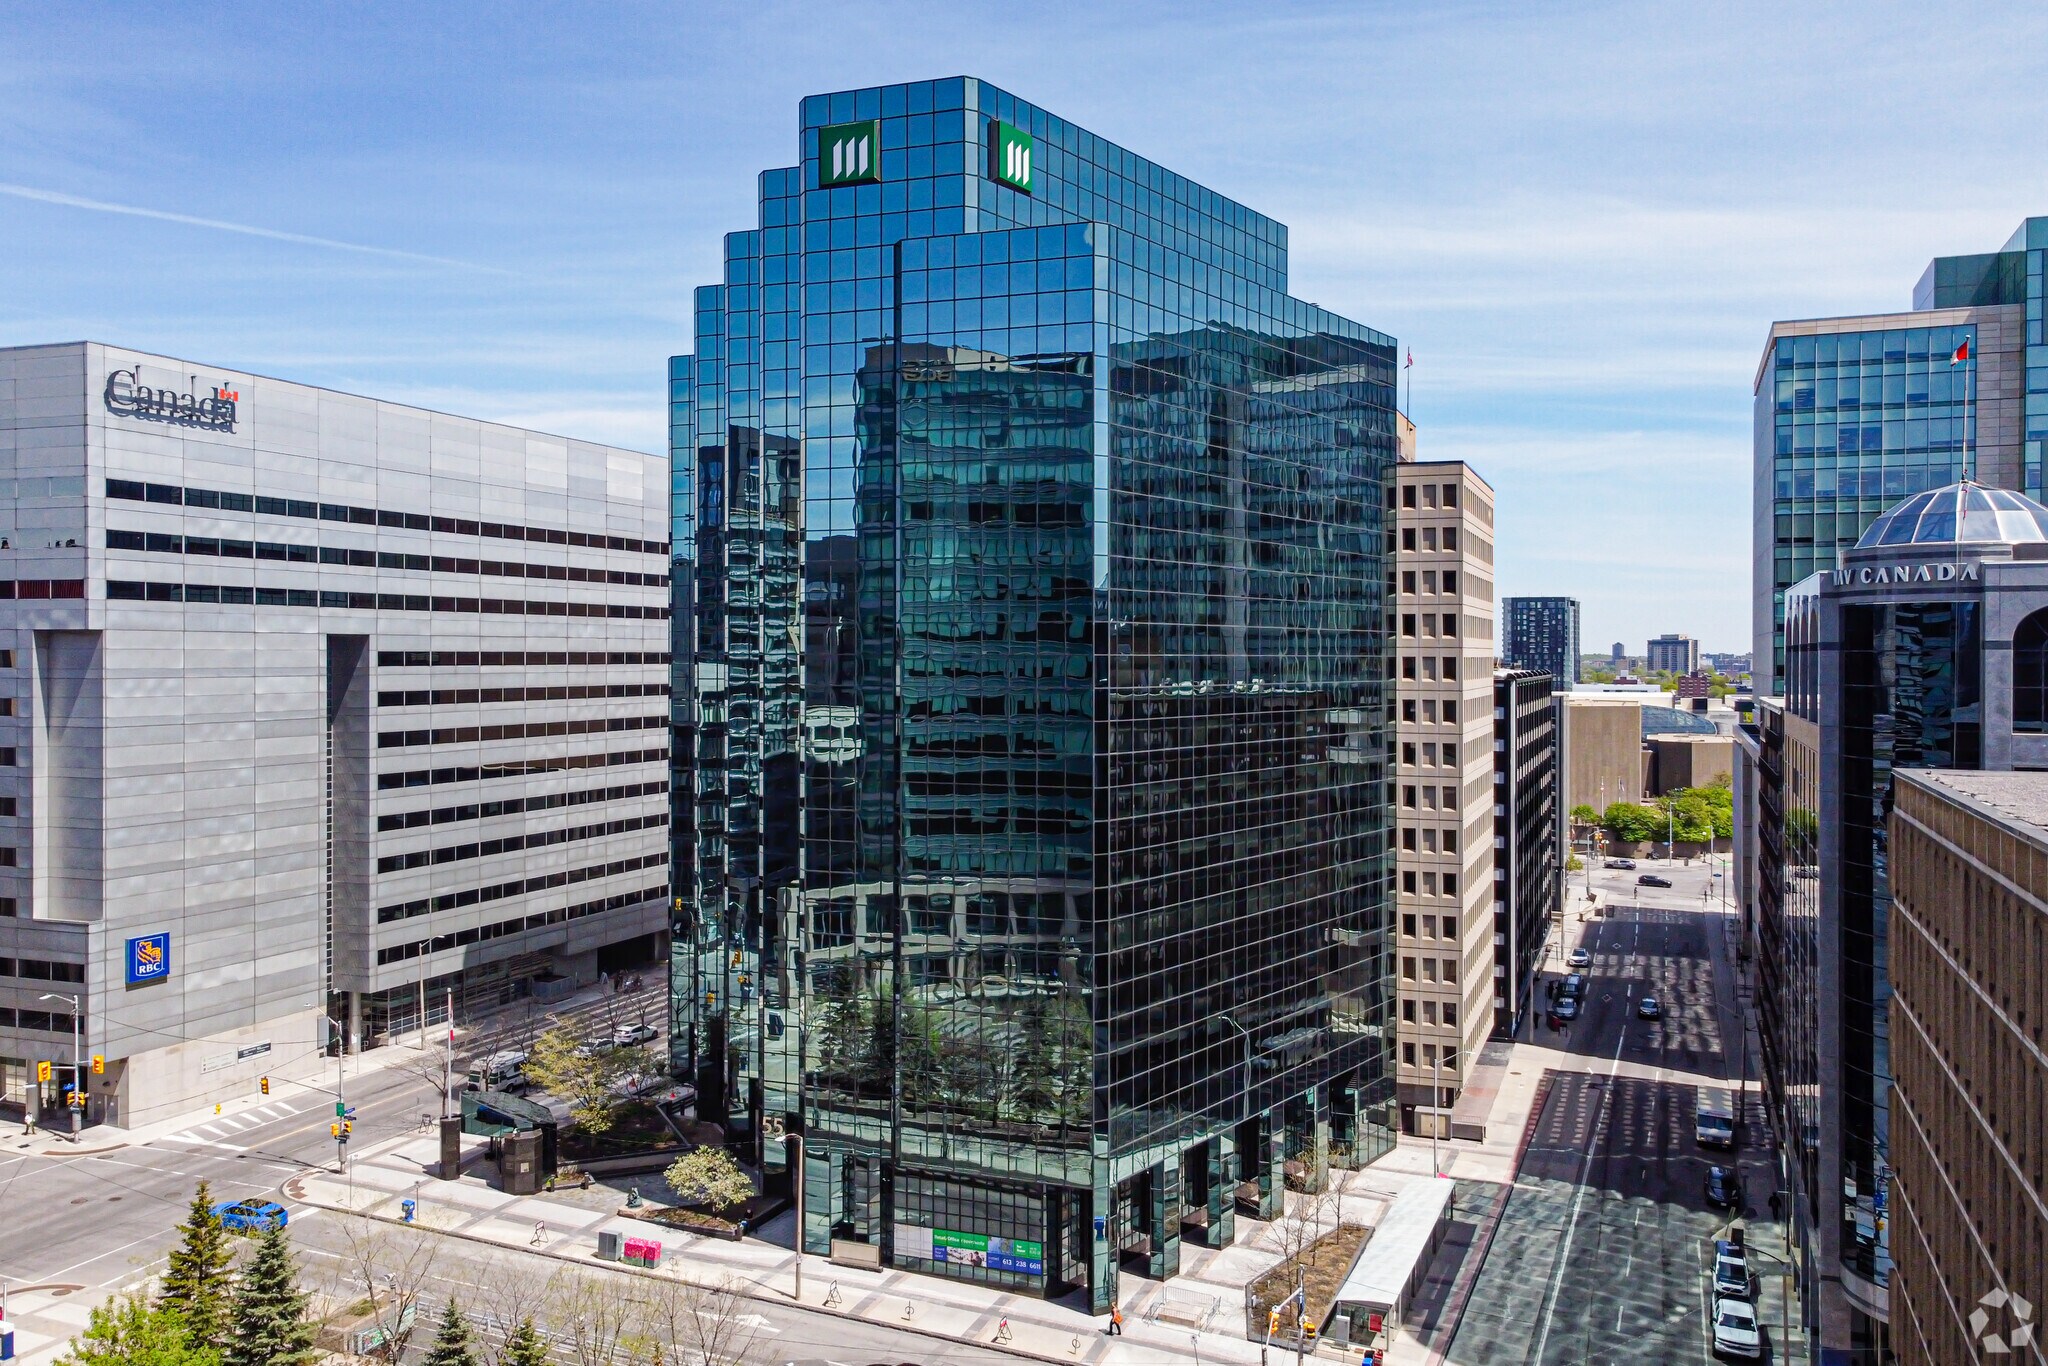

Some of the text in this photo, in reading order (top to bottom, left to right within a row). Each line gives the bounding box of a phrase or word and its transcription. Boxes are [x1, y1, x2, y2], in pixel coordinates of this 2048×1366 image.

[106, 369, 239, 423] Canada
[1860, 565, 1978, 584] CANADA
[139, 962, 160, 974] RBC
[762, 1116, 784, 1136] 55
[1002, 1258, 1012, 1266] 613
[1015, 1260, 1027, 1268] 238
[1029, 1262, 1041, 1270] 6611
